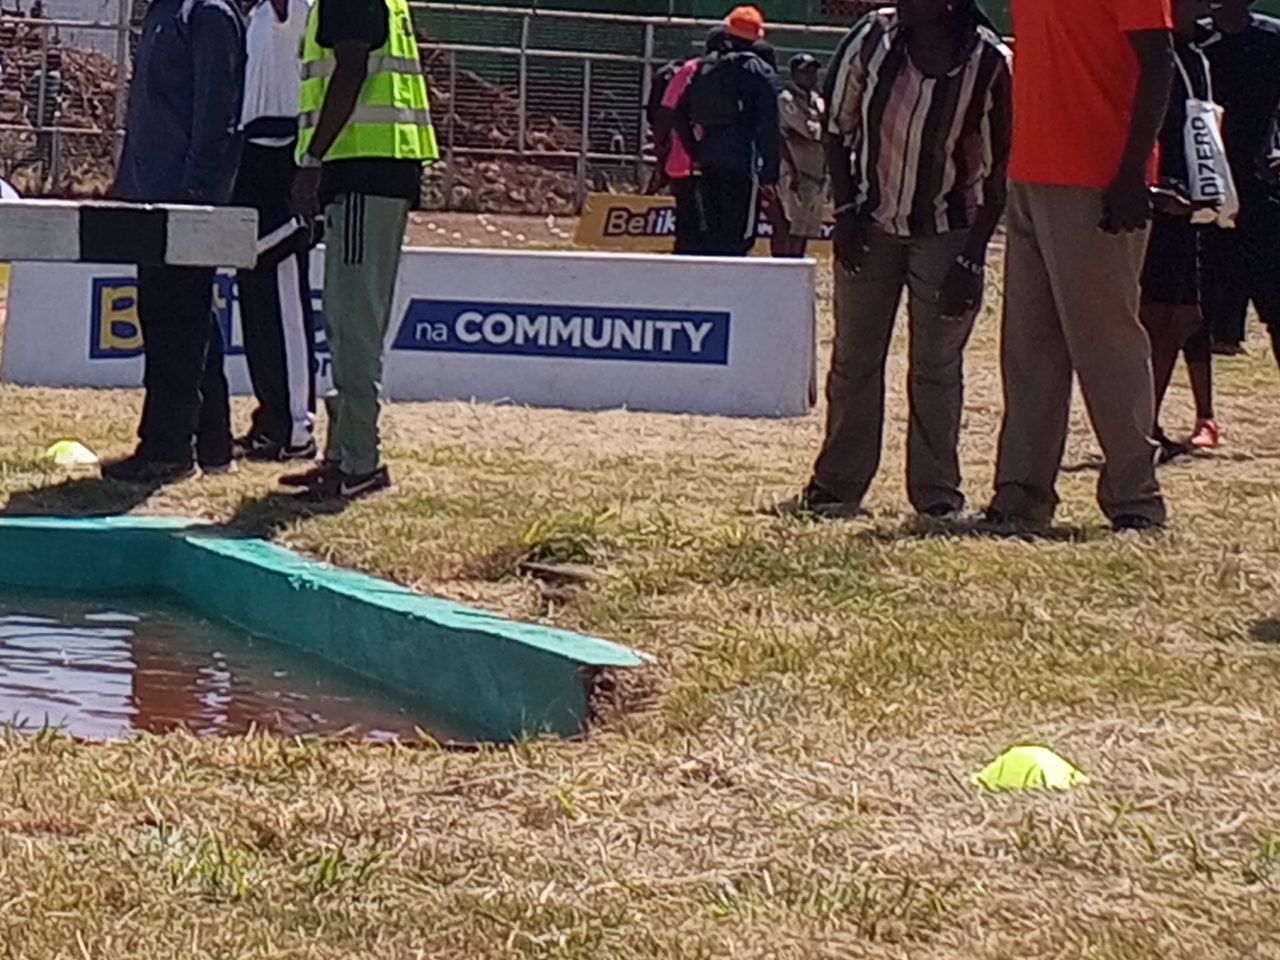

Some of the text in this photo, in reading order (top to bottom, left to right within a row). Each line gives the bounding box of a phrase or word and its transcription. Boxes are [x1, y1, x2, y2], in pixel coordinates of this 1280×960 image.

[607, 209, 676, 235] Betik
[415, 311, 714, 353] na COMMUNITY
